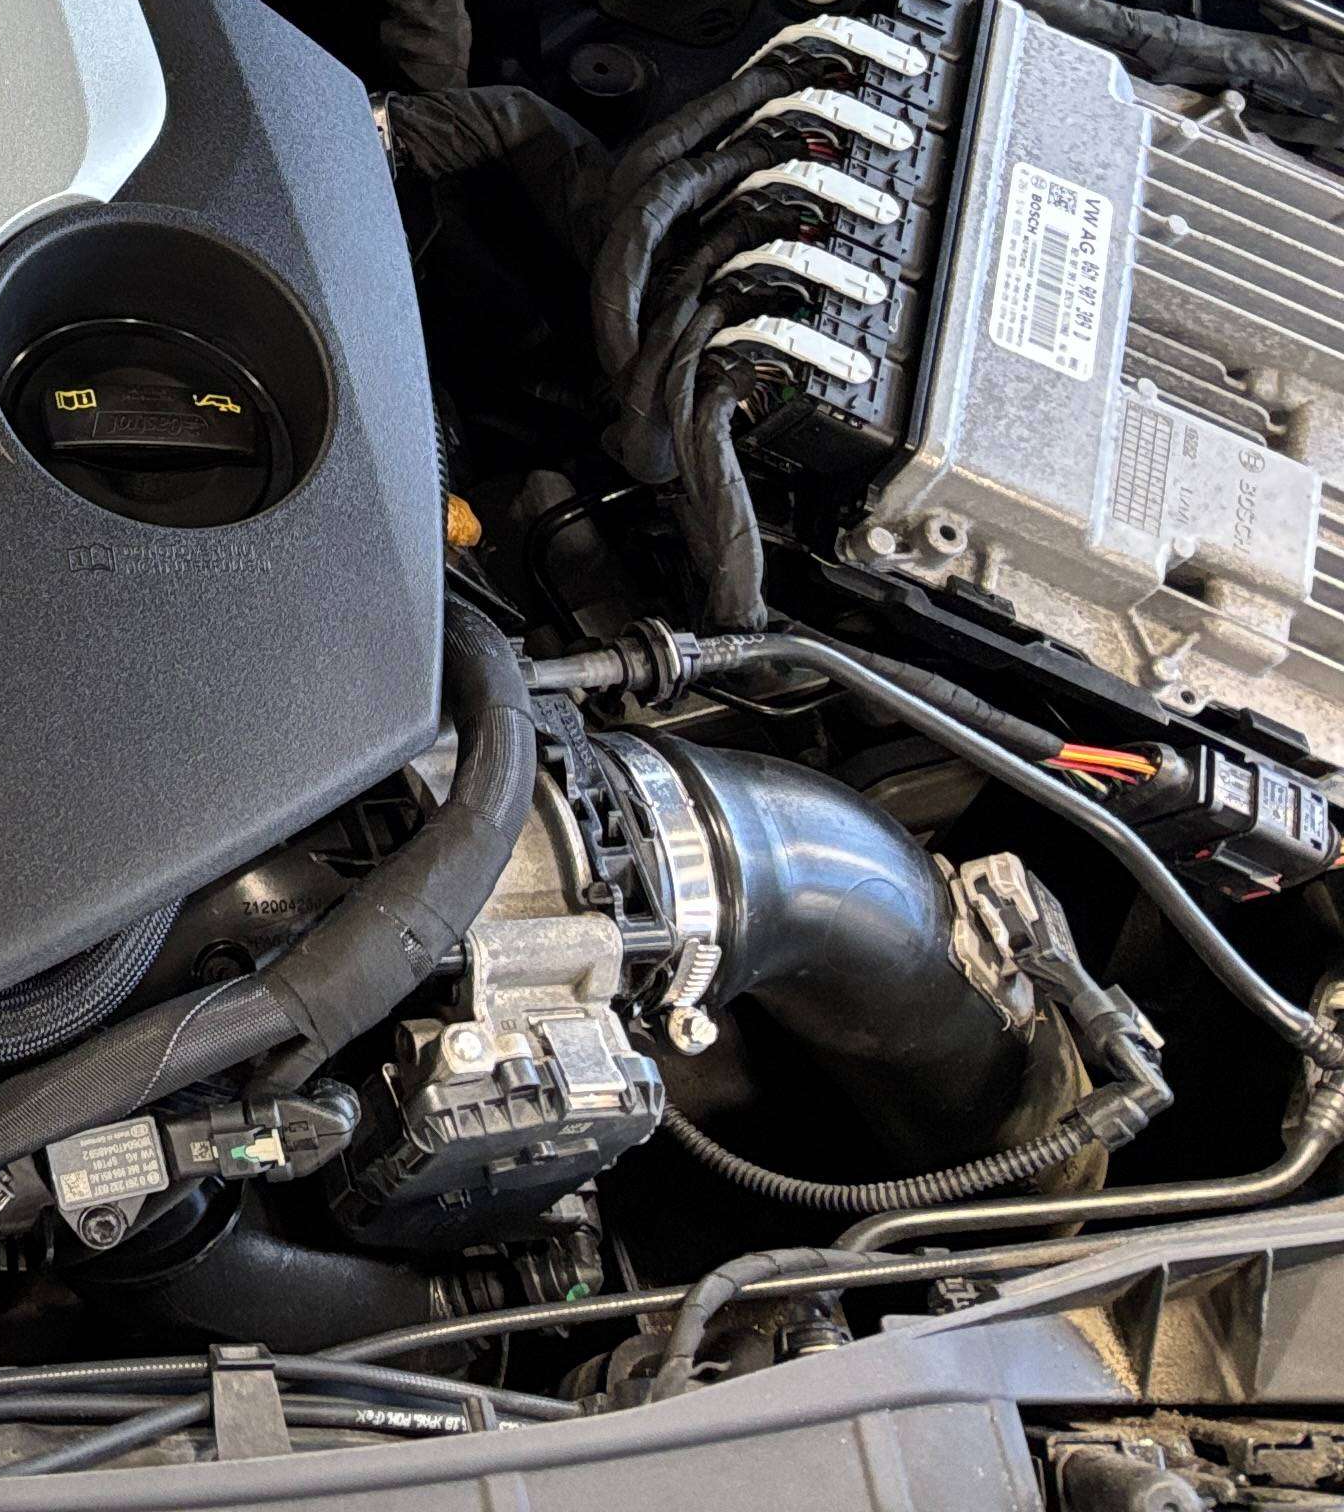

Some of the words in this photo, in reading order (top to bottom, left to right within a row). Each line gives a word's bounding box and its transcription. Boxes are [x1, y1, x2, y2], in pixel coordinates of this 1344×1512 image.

[1026, 192, 1041, 235] BOSCH
[1083, 199, 1100, 227] VW
[1078, 227, 1097, 256] AG
[1232, 478, 1258, 553] BOSCH
